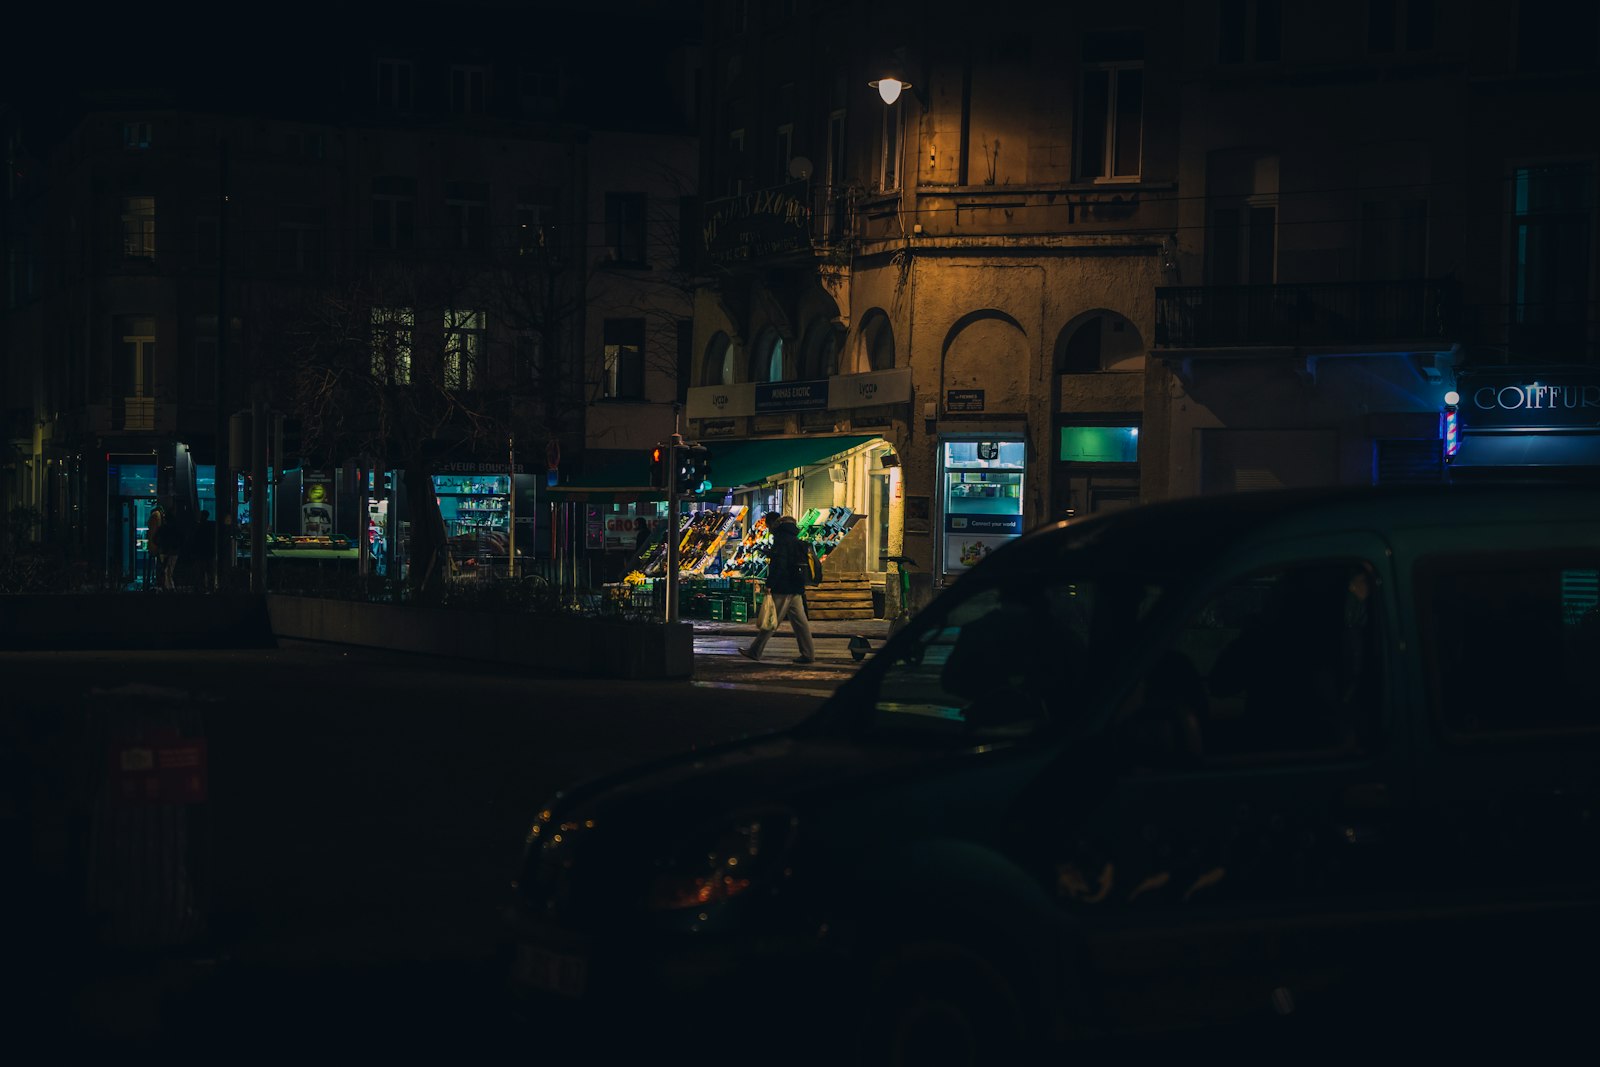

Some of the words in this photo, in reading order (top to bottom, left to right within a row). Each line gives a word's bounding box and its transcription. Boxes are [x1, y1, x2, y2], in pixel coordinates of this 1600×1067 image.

[792, 386, 811, 398] EXOTIC
[1474, 384, 1600, 410] COIFFUR
[478, 463, 524, 473] BOUCHER
